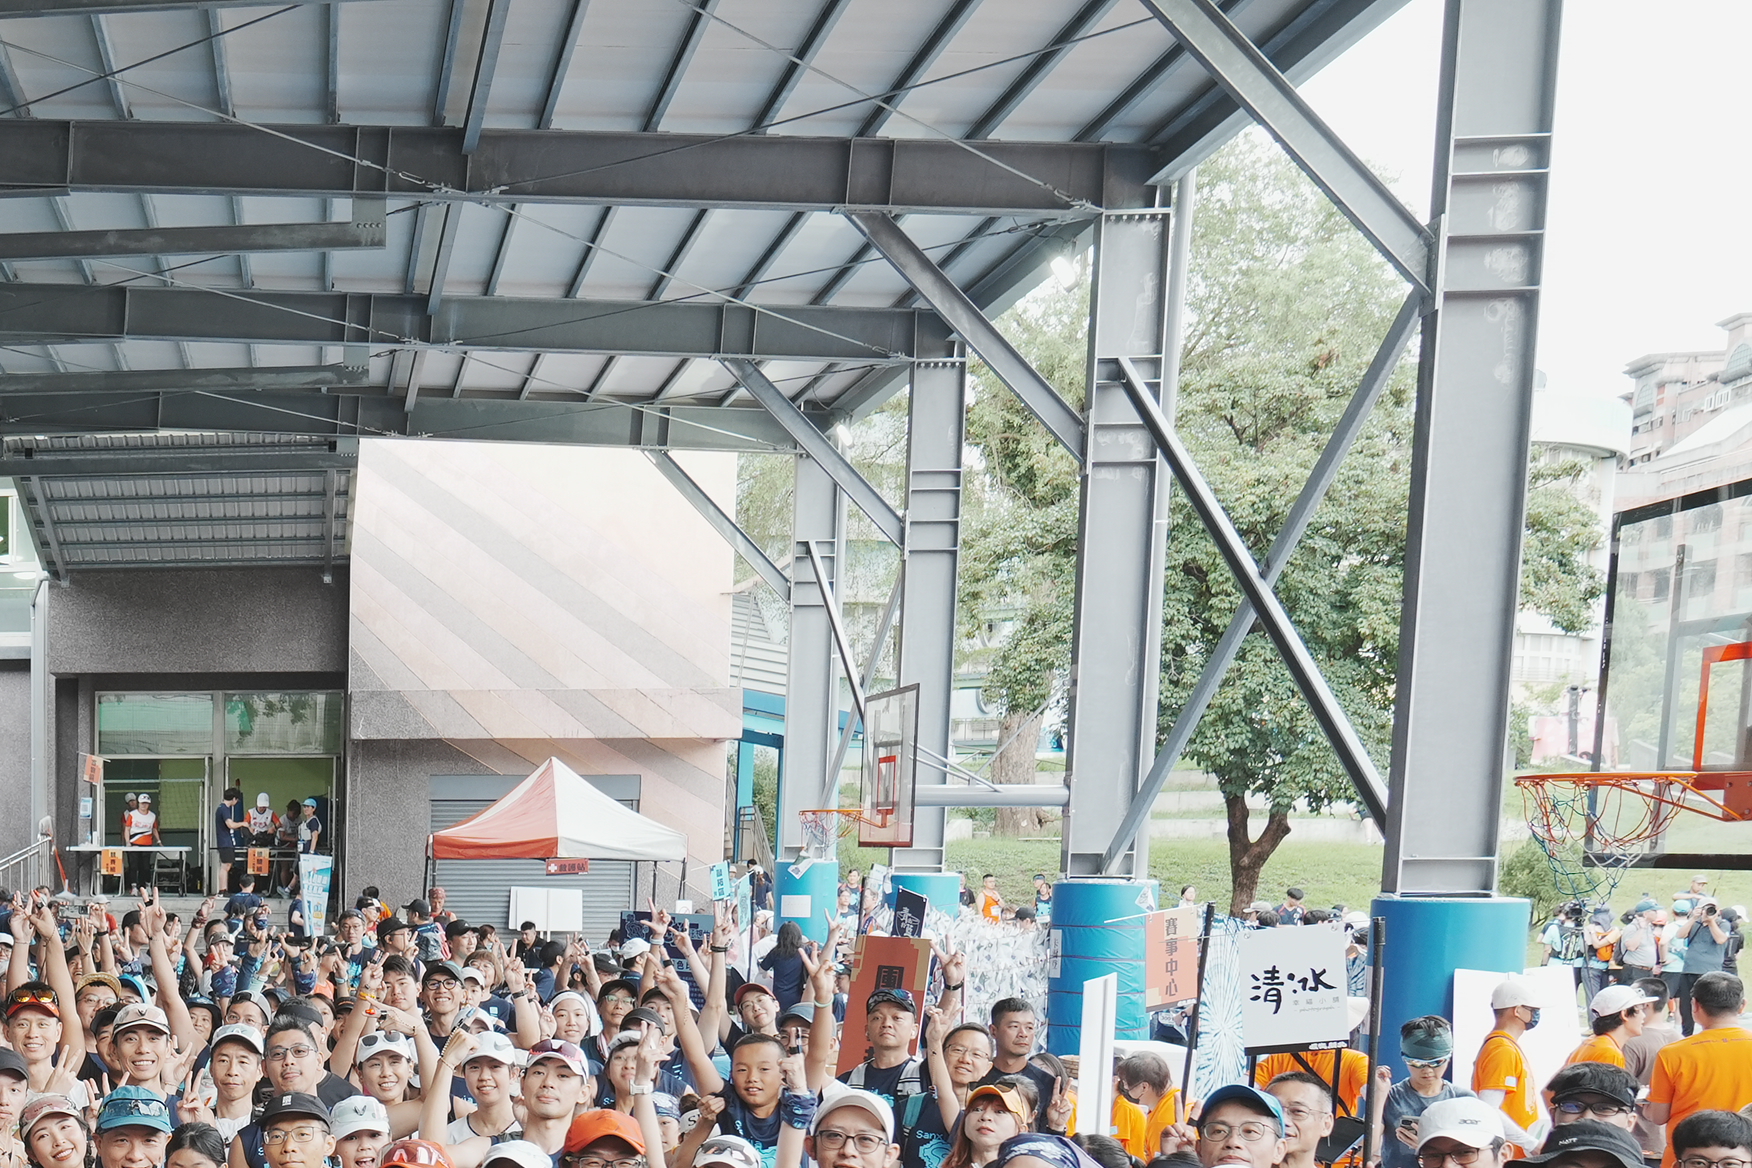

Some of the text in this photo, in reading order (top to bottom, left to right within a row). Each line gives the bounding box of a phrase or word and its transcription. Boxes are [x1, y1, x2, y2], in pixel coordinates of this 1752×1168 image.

[1164, 917, 1179, 997] 賽事中心
[915, 1129, 943, 1140] Sanx
